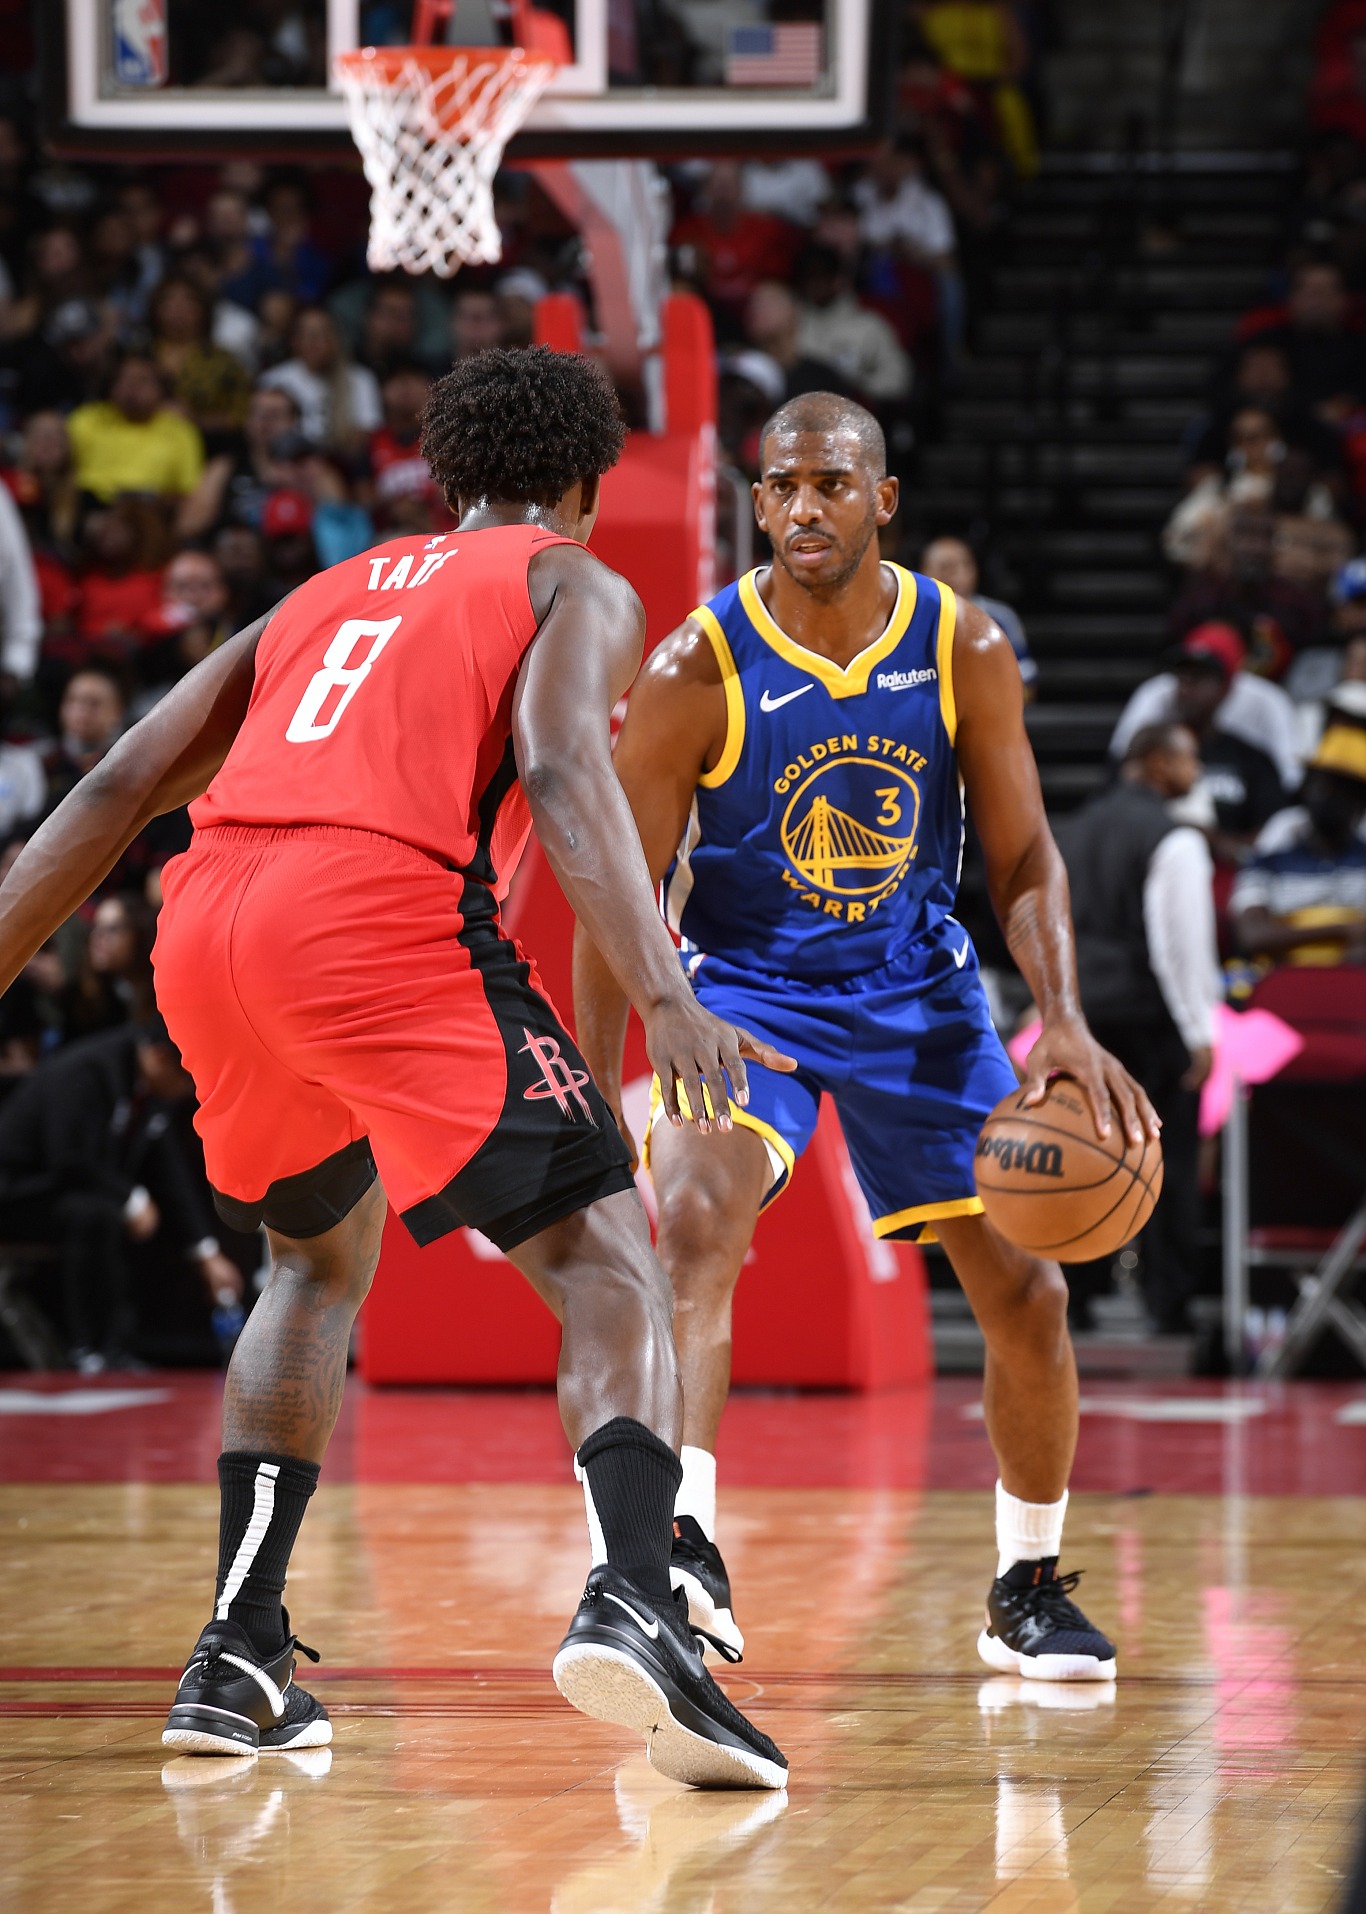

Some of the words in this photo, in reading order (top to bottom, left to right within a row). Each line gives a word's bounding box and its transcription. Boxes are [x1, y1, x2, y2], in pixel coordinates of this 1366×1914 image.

[285, 615, 403, 743] 8
[877, 667, 938, 690] Rakuten
[774, 734, 858, 795] GOLDEN
[867, 735, 928, 773] STATE
[874, 786, 902, 826] 3
